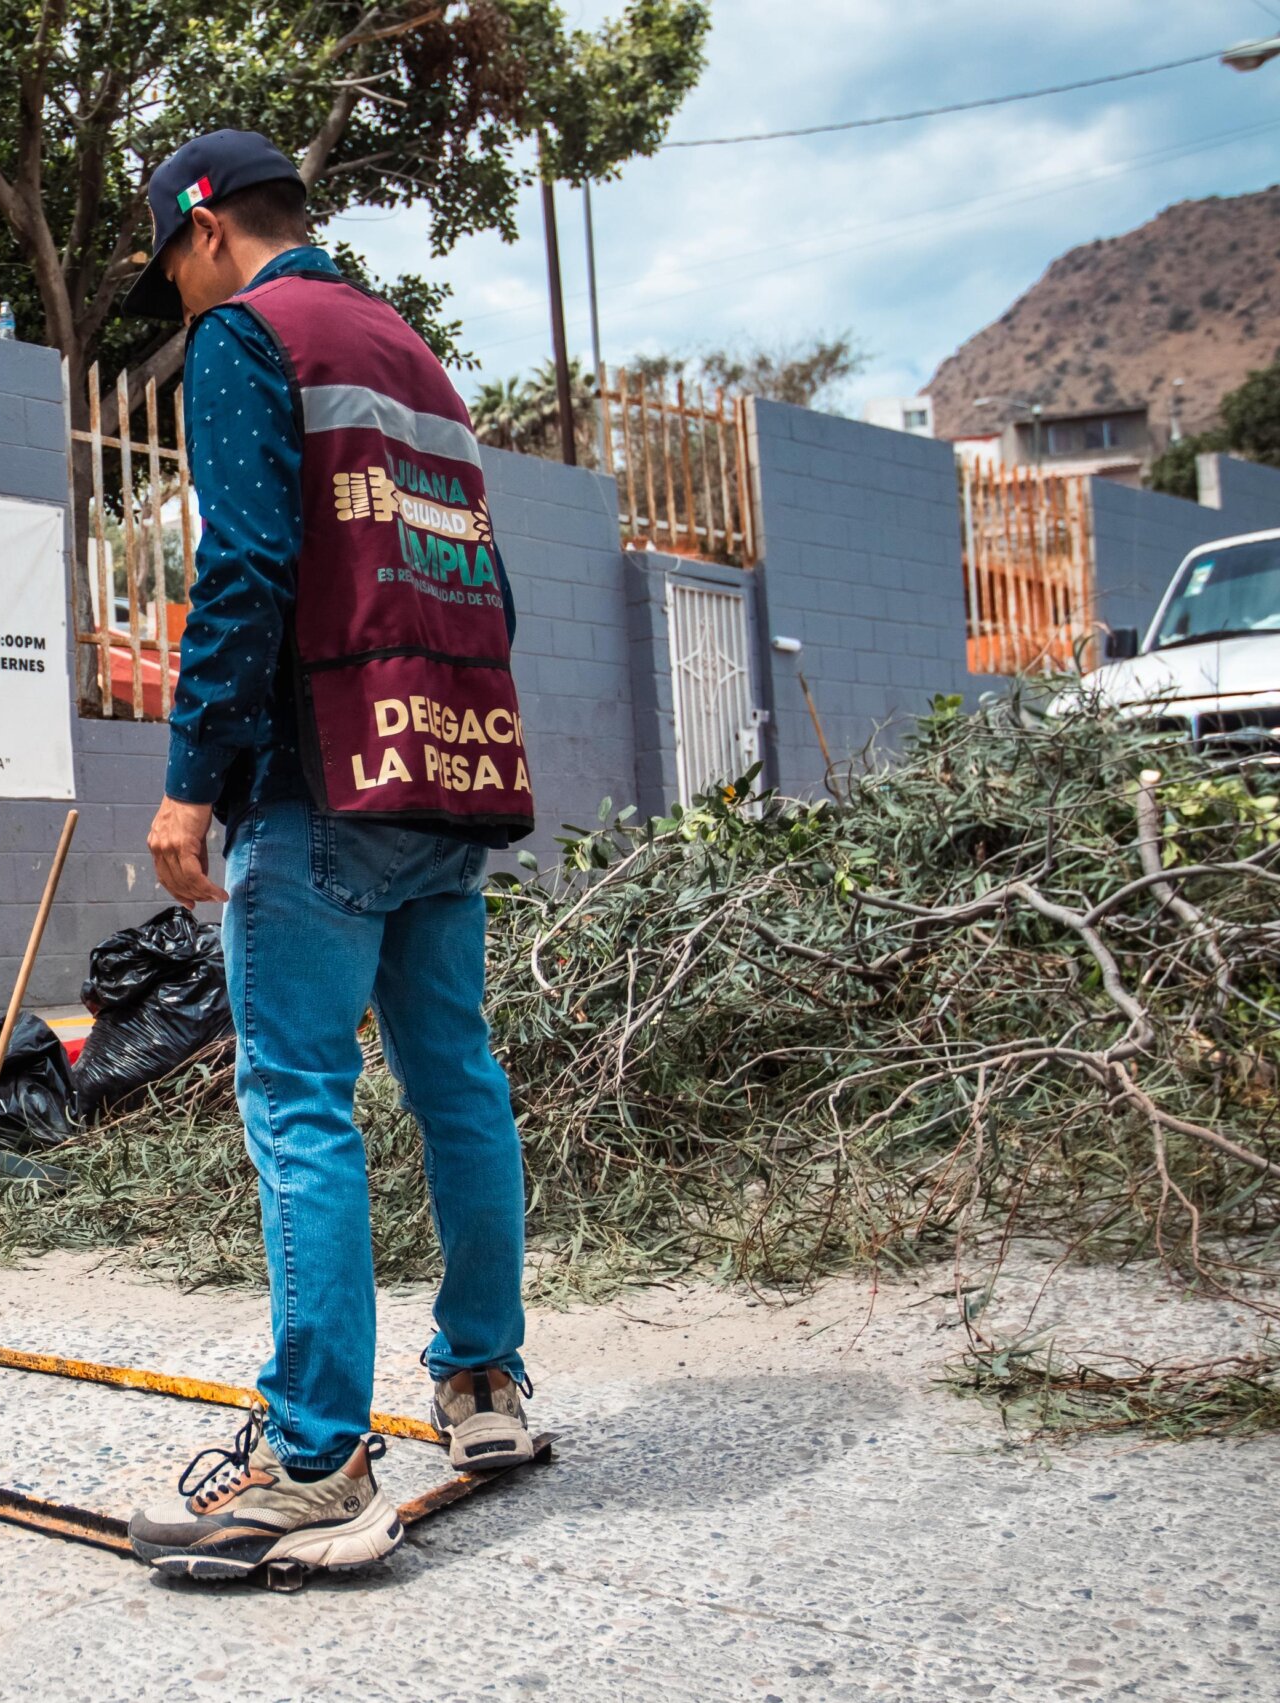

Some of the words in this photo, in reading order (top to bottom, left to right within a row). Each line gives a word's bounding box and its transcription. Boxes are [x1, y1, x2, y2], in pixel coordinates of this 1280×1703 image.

[401, 498, 466, 534] CIUDAD
[377, 568, 394, 582] ES
[468, 591, 483, 605] DE
[351, 747, 412, 790] LA
[424, 744, 504, 792] PESA
